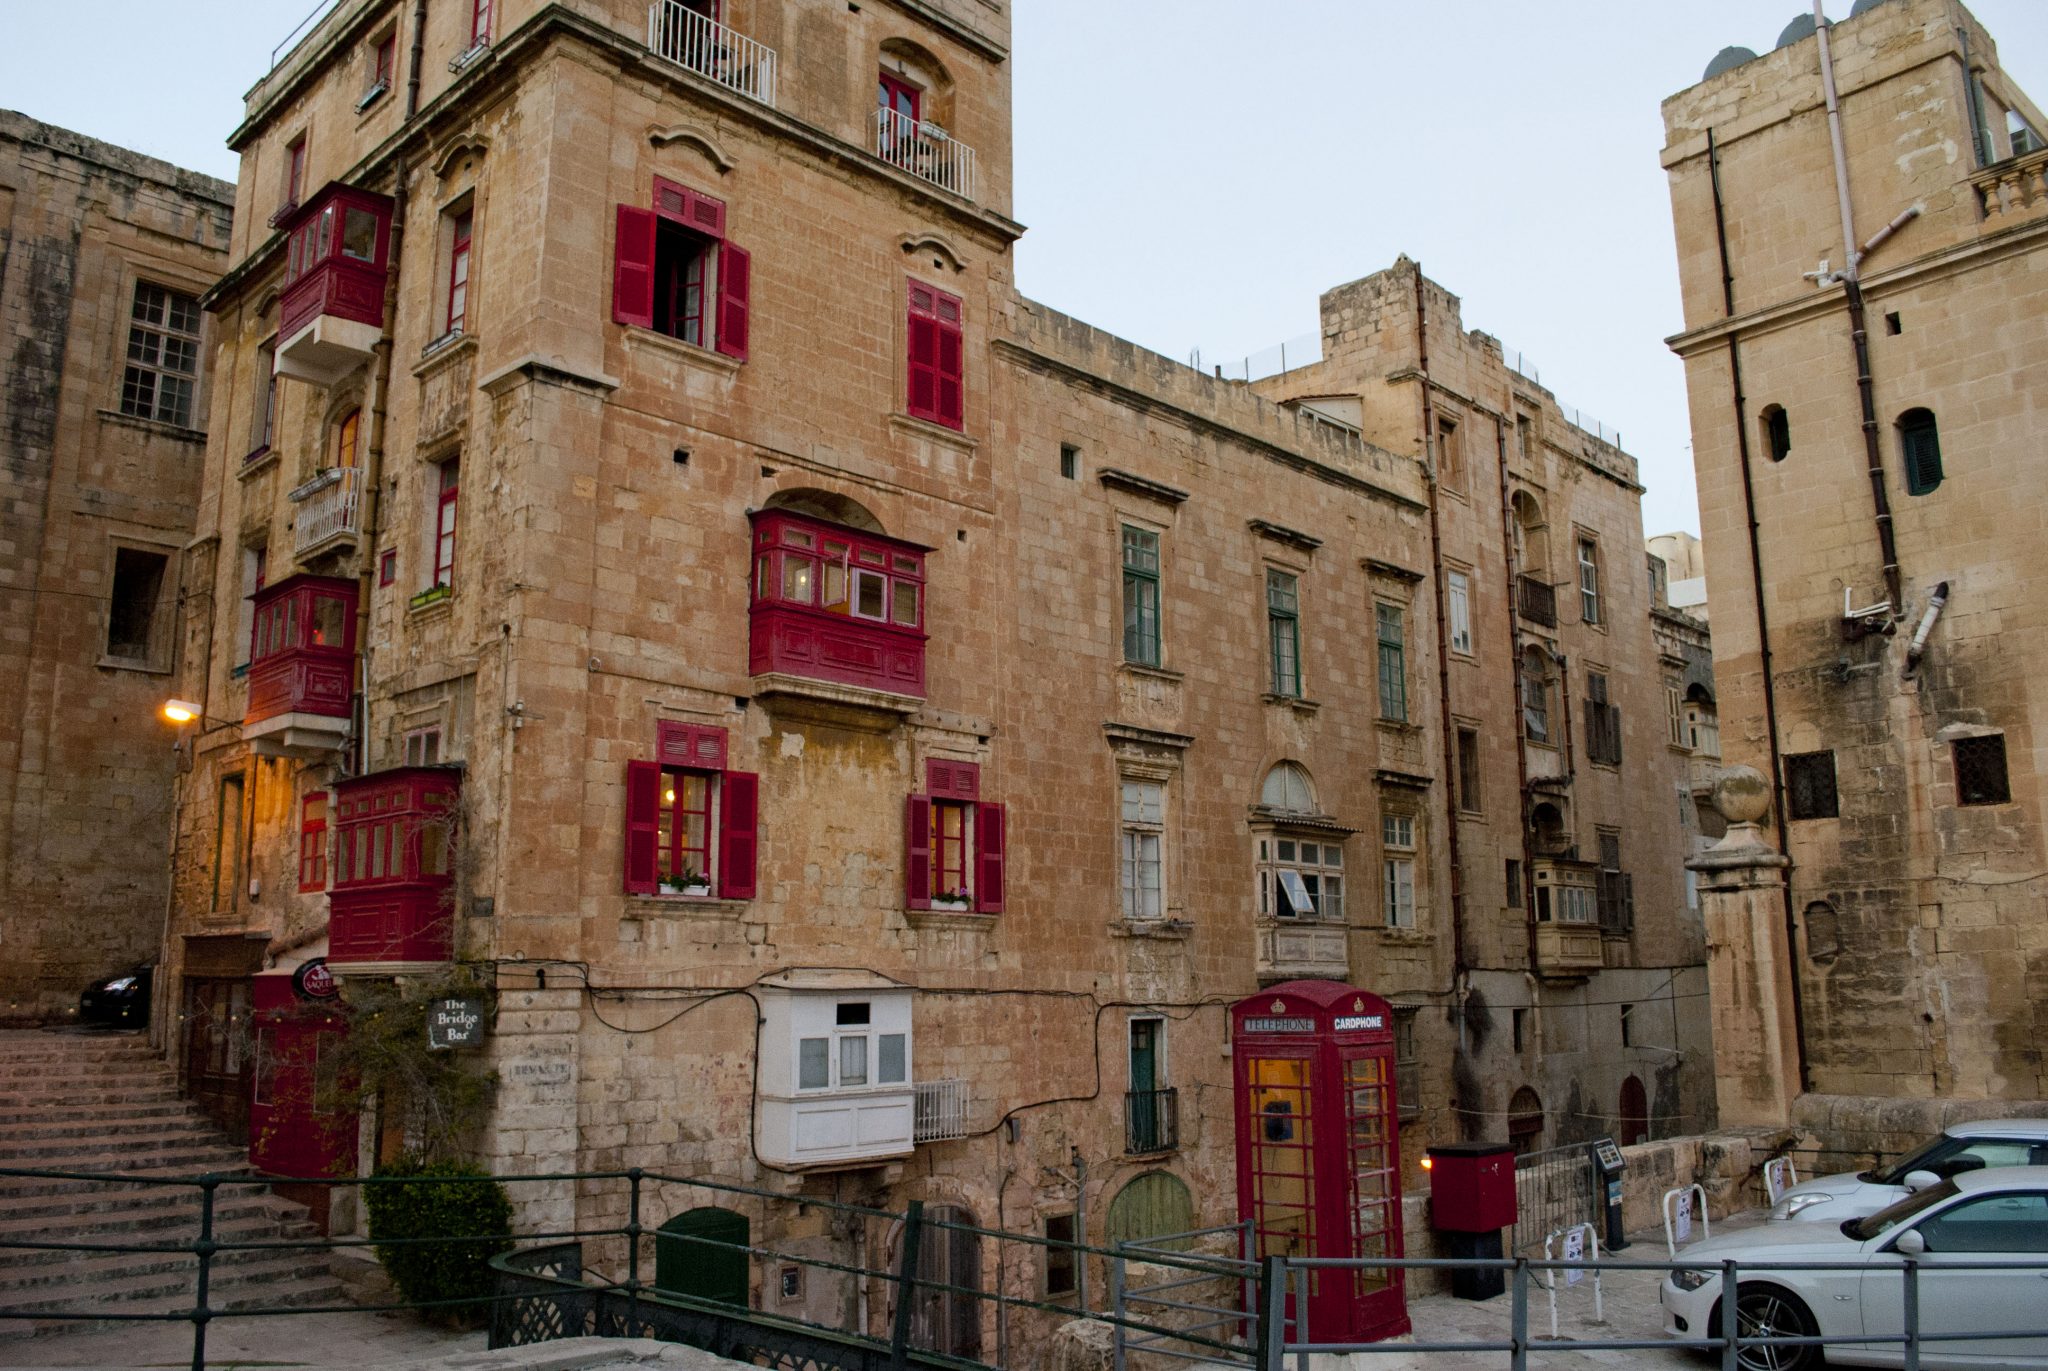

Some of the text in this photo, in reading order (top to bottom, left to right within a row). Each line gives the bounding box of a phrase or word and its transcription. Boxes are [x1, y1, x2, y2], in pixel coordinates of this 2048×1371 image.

[445, 1000, 466, 1009] The
[437, 1011, 478, 1030] Bridge
[1248, 1018, 1311, 1030] TELEPHONE
[1334, 1016, 1382, 1030] CARDPHONE
[447, 1028, 469, 1040] Bar
